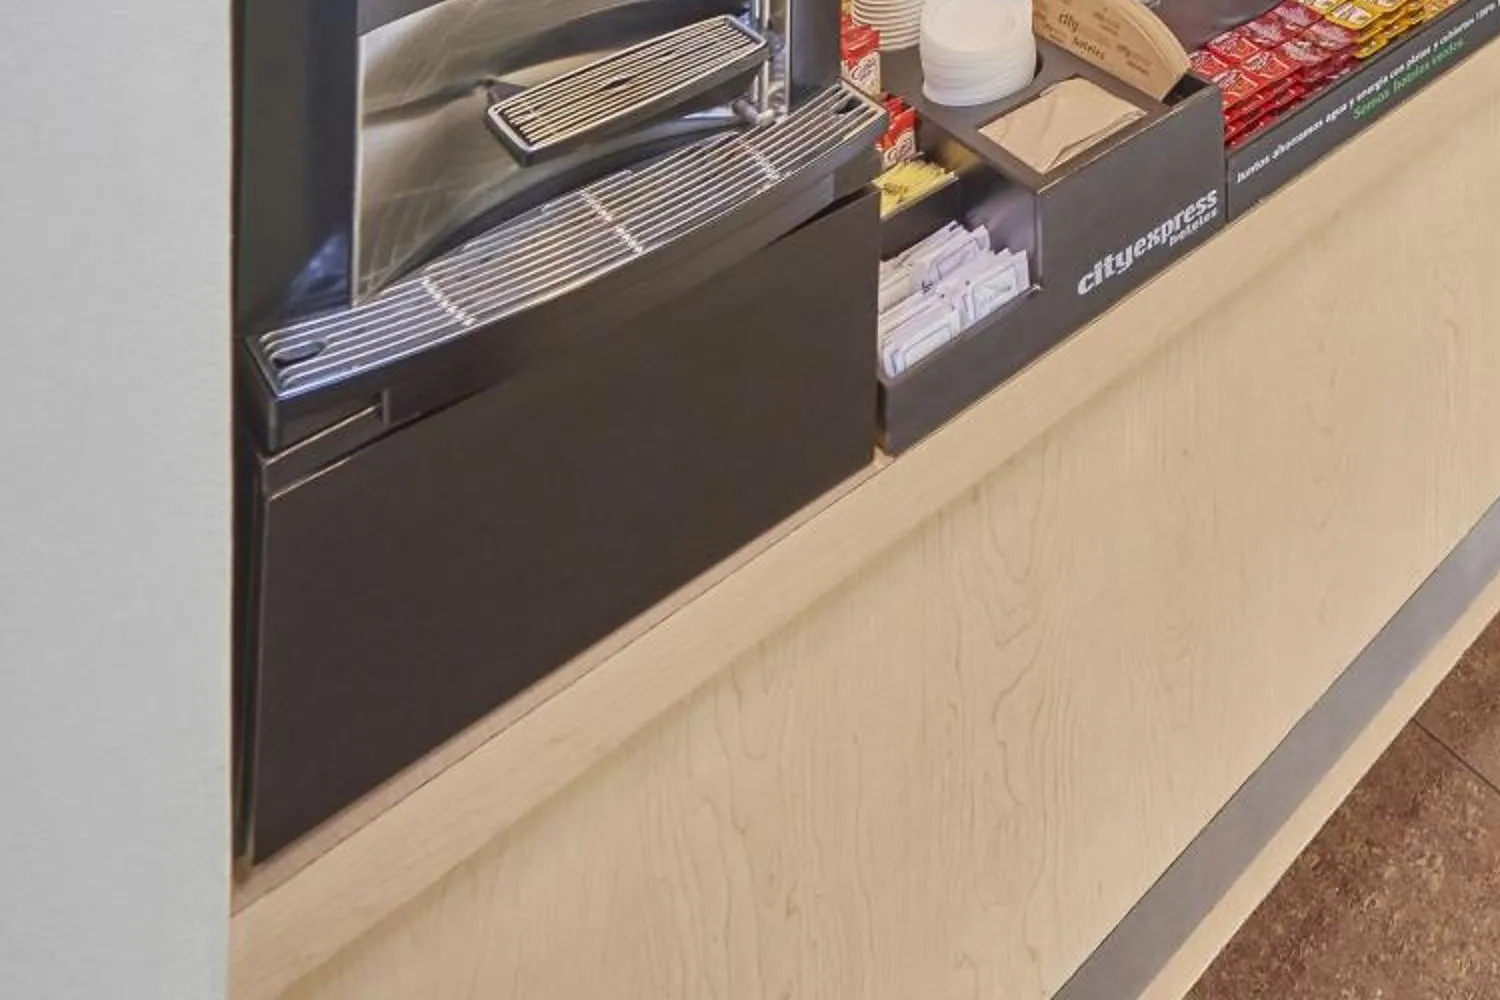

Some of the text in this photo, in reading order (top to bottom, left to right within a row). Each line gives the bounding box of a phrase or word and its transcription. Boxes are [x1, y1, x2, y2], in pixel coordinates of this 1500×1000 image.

[1325, 102, 1348, 123] agua
[1389, 63, 1406, 80] con
[1406, 46, 1431, 70] platos
[1168, 206, 1217, 248] hoteles
